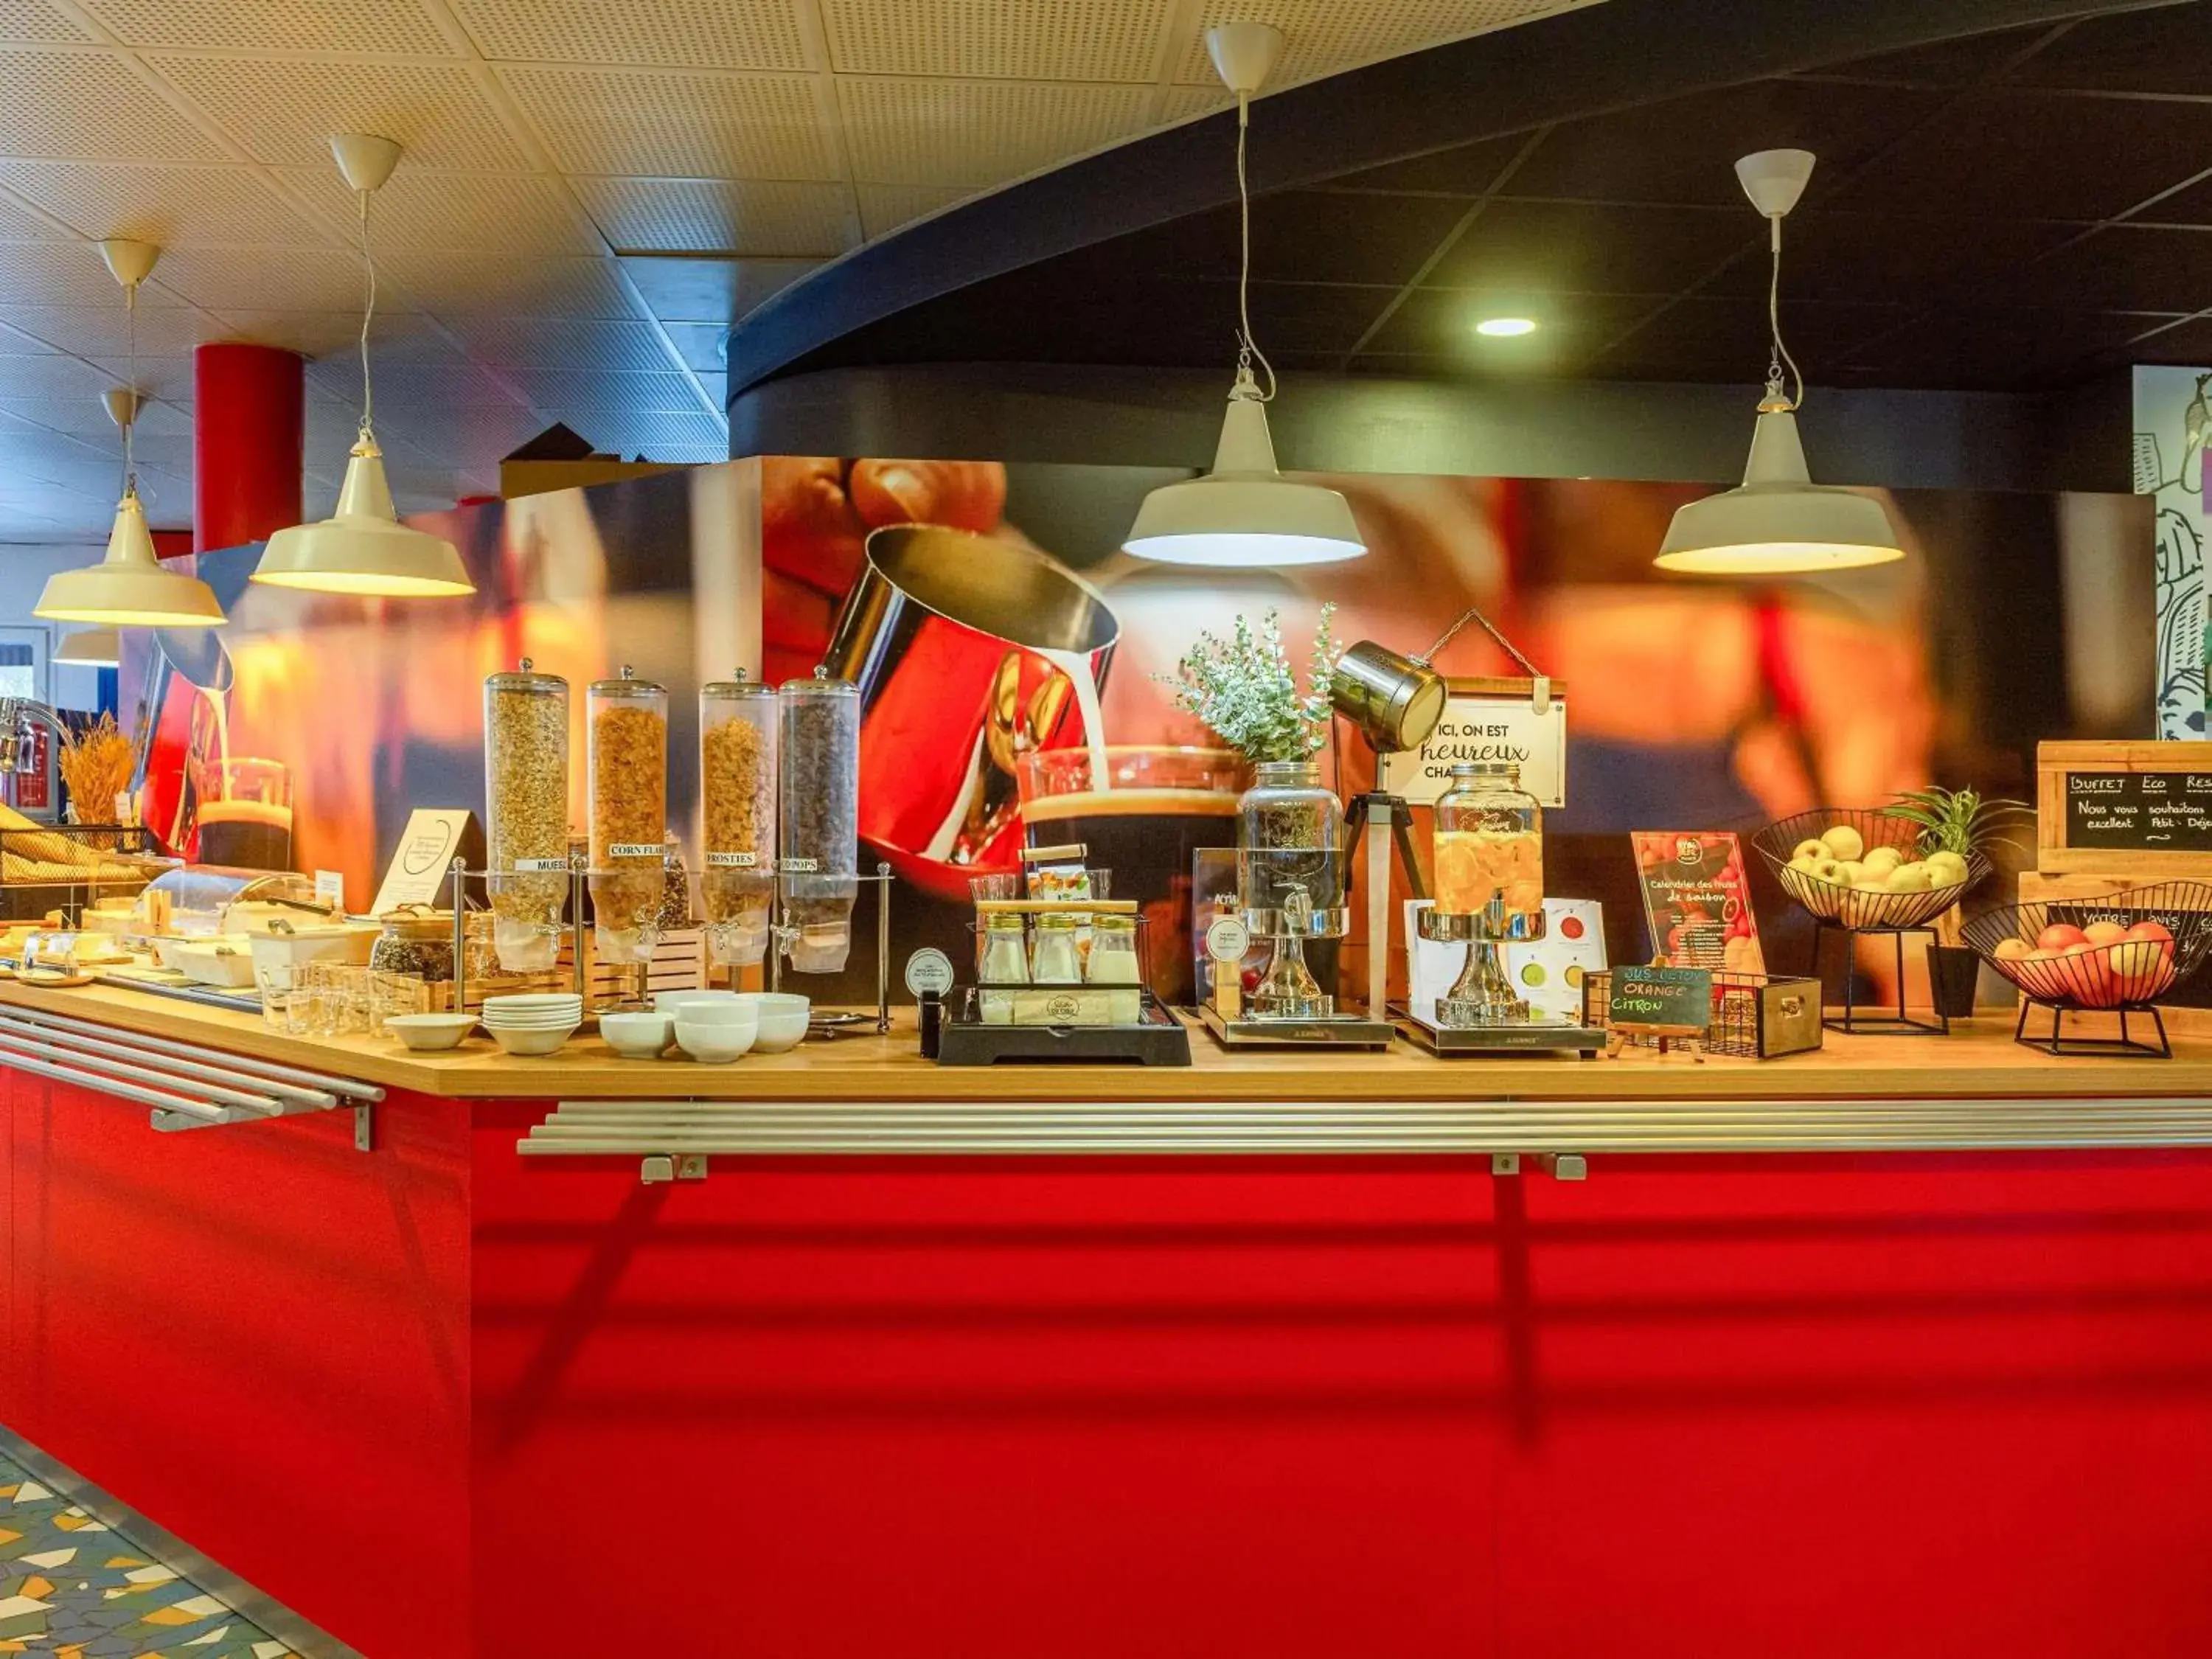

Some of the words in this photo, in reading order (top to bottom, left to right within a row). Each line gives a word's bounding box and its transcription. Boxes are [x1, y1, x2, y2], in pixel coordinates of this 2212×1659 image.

[1439, 725, 1458, 737] ICI,
[1462, 725, 1483, 736] ON
[1487, 725, 1509, 737] EST
[1420, 737, 1530, 762] heureux
[2079, 800, 2107, 814] Nous
[2149, 801, 2205, 814] souhaitons
[2087, 817, 2135, 829] excellent
[611, 845, 641, 855] CORN
[707, 853, 753, 863] FROSTIES
[1697, 880, 1713, 888] des
[1667, 889, 1681, 901] de
[1624, 967, 1652, 979] JUS
[1624, 982, 1688, 996] ORANGE
